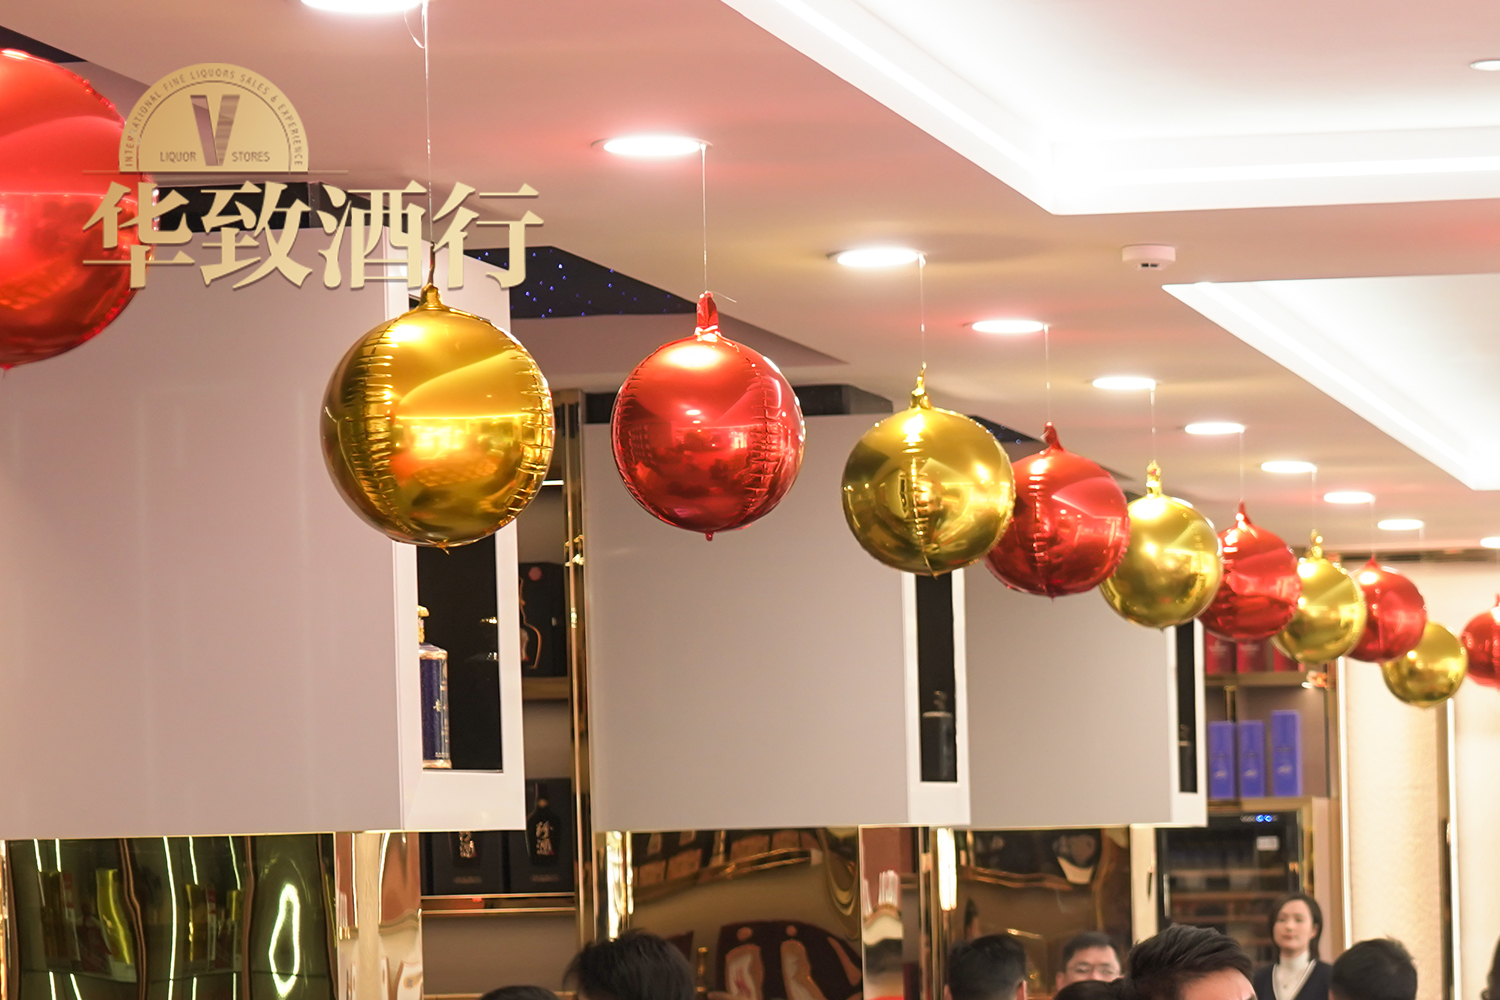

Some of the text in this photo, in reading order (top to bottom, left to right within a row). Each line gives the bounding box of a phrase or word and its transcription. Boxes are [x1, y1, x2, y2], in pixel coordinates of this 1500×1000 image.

[124, 91, 162, 168] INTERNATIONAL
[163, 74, 187, 92] FINE
[190, 68, 236, 80] LIQUORS
[239, 73, 271, 96] SALES
[278, 103, 304, 167] EXPERIENCE
[159, 151, 271, 163] LIQUOR STORES
[190, 94, 241, 167] V
[82, 180, 545, 290] 华致酒行
